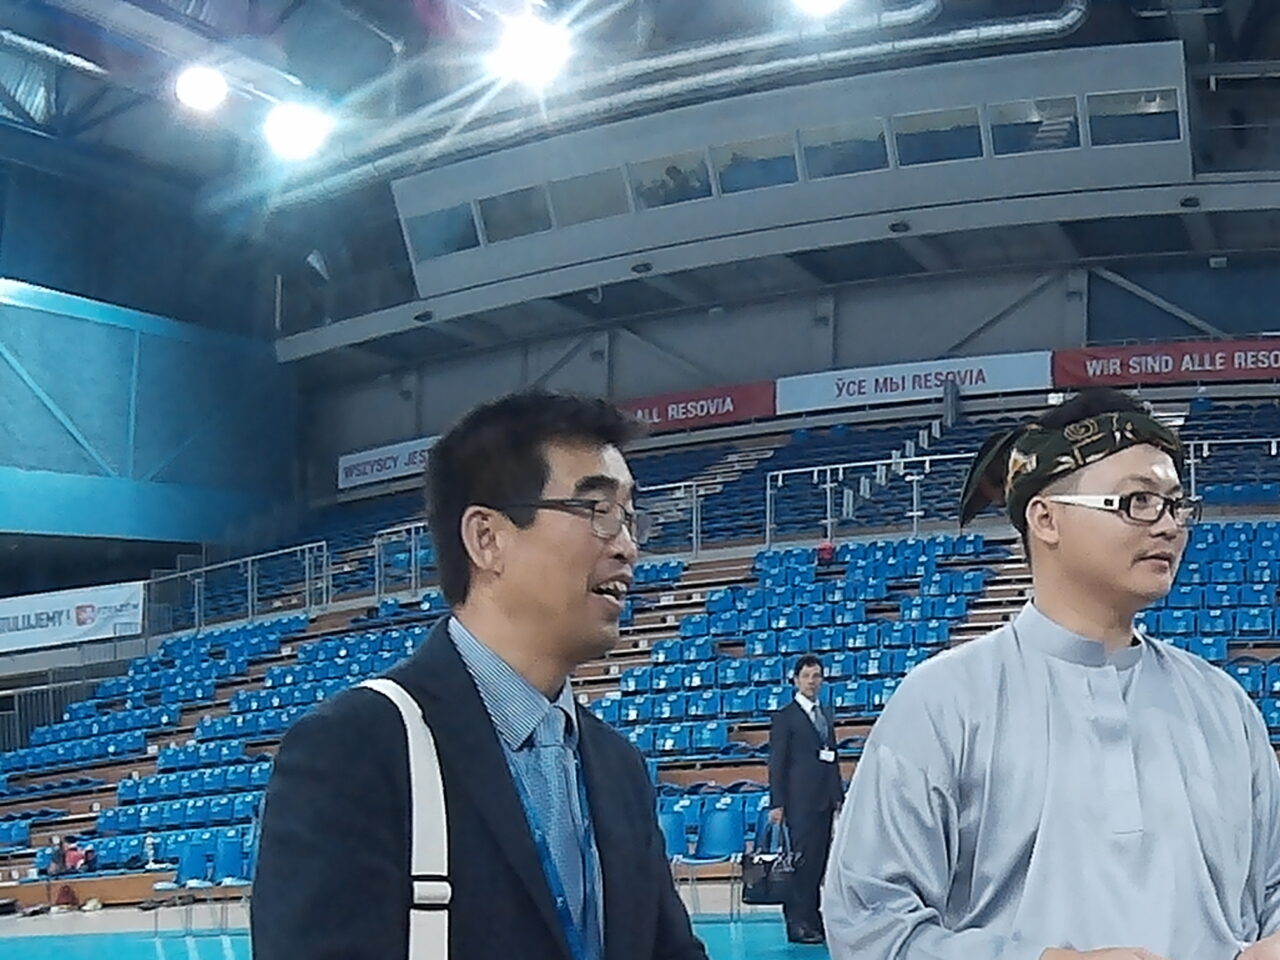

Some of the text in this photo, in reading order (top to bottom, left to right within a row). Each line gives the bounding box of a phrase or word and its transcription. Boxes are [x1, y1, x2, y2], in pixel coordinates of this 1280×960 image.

[1086, 360, 1122, 377] WIR
[1128, 356, 1174, 375] SIND
[1181, 353, 1226, 371] ALLE
[912, 368, 987, 391] RESOVIA
[667, 396, 735, 421] RESOVIA
[342, 455, 401, 479] WSZYSCY
